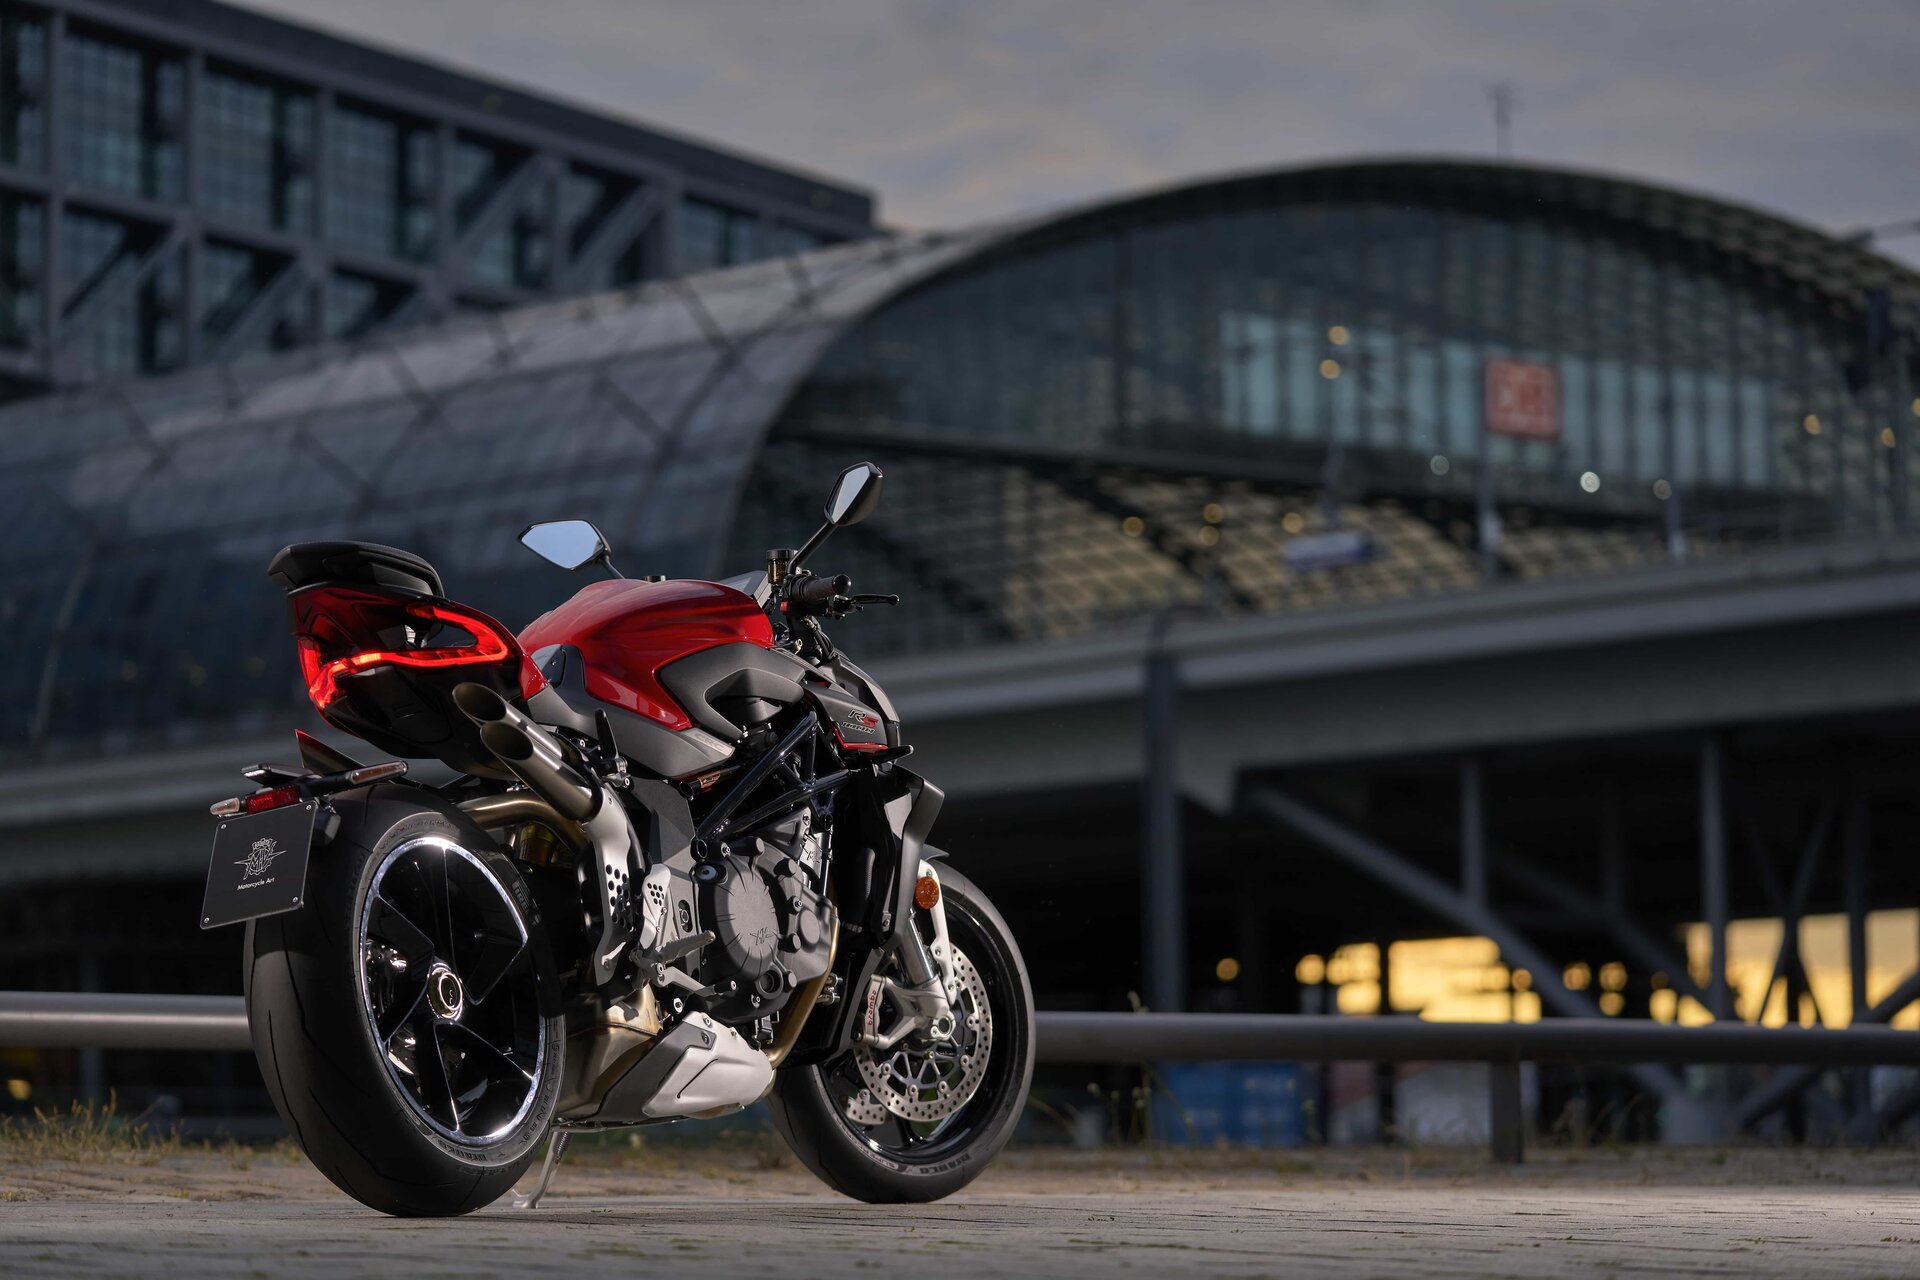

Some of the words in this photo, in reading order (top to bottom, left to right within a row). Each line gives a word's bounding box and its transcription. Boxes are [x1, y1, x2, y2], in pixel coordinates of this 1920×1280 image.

[848, 709, 879, 728] RS
[237, 879, 265, 890] Motorcycle
[867, 990, 877, 1026] brembo
